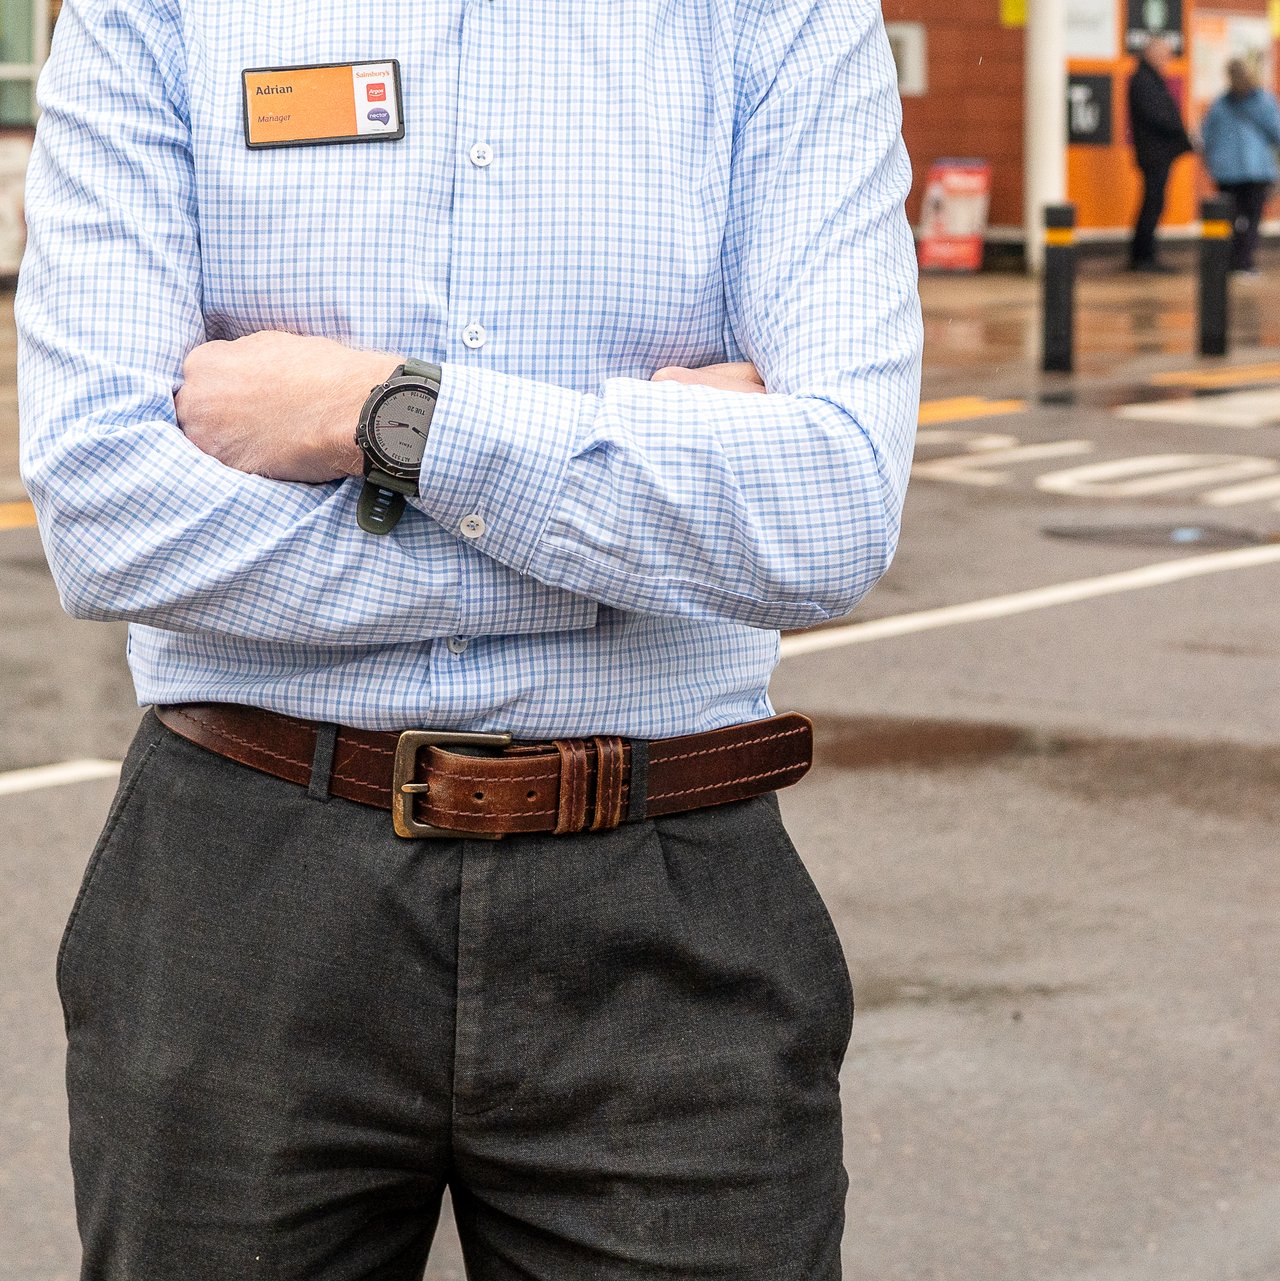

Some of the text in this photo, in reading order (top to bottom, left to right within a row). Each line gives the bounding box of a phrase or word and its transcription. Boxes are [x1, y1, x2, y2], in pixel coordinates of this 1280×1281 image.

[355, 70, 390, 79] Sainsbury's
[255, 84, 293, 96] Adrian
[257, 114, 292, 124] Manager
[415, 407, 426, 416] TUE
